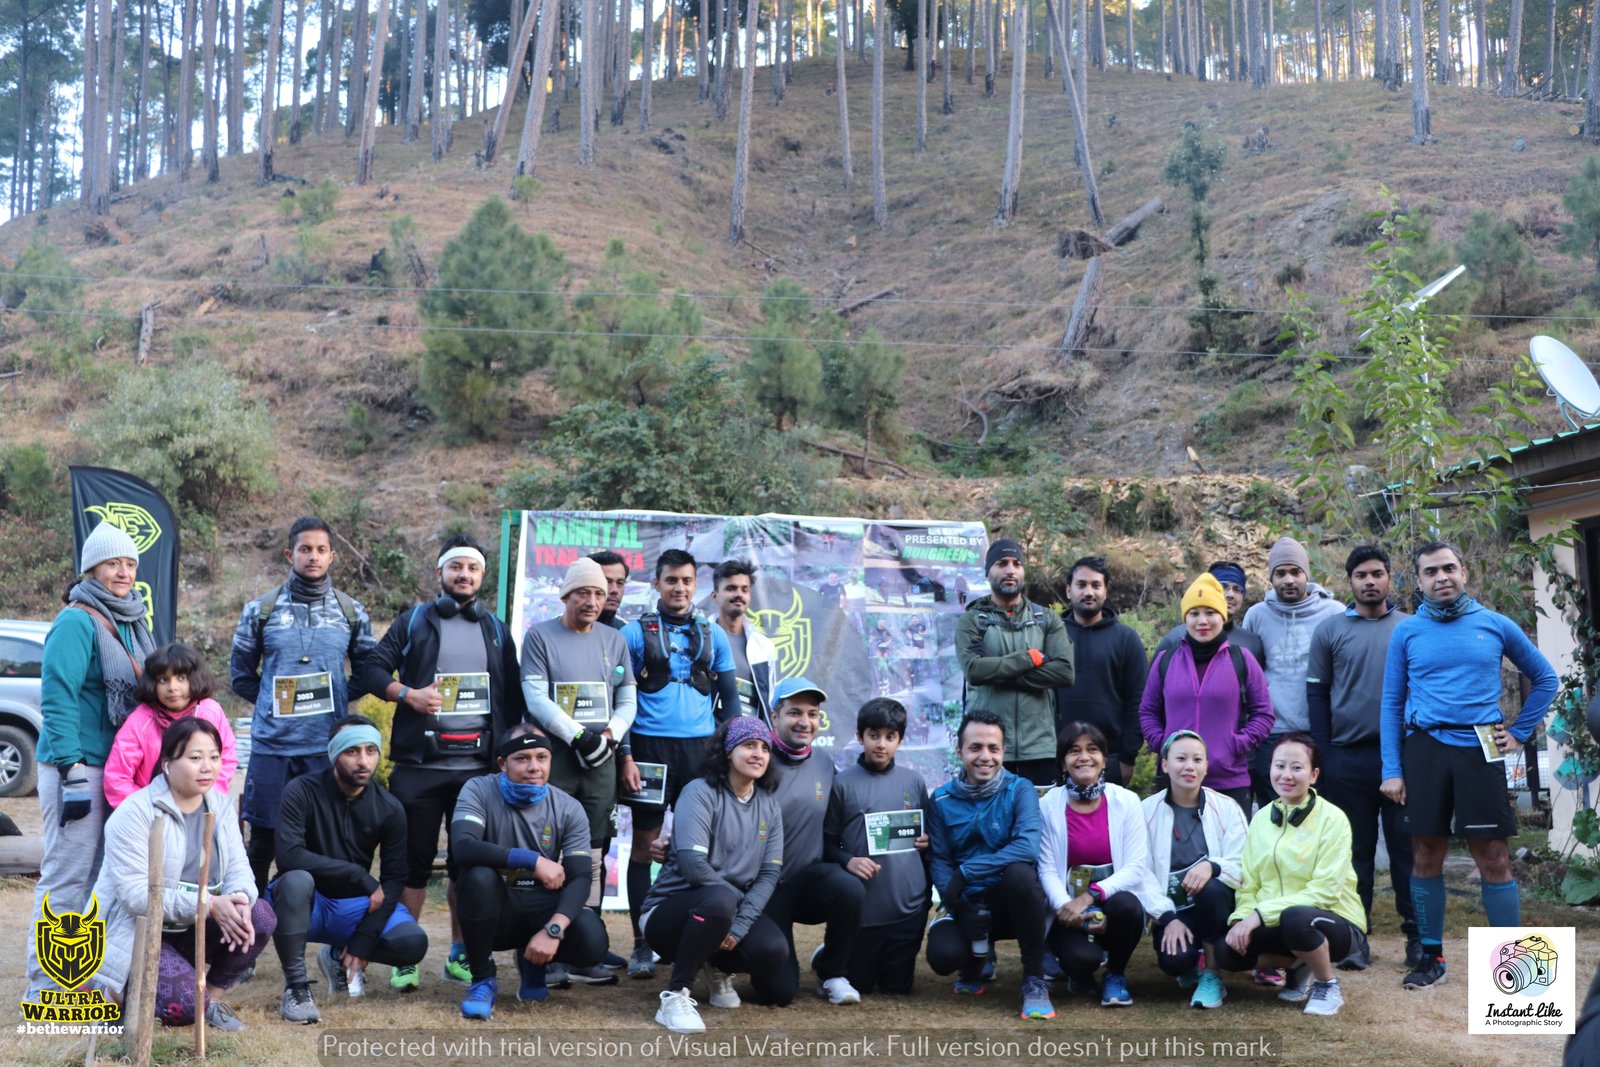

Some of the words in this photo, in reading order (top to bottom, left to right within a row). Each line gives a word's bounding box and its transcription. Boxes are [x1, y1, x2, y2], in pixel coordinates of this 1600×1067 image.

[535, 518, 644, 549] NAINITAL
[904, 534, 967, 545] PRESENTED
[969, 537, 984, 546] BY
[296, 692, 314, 701] 3003
[458, 691, 476, 700] 3002
[576, 699, 593, 708] 3011
